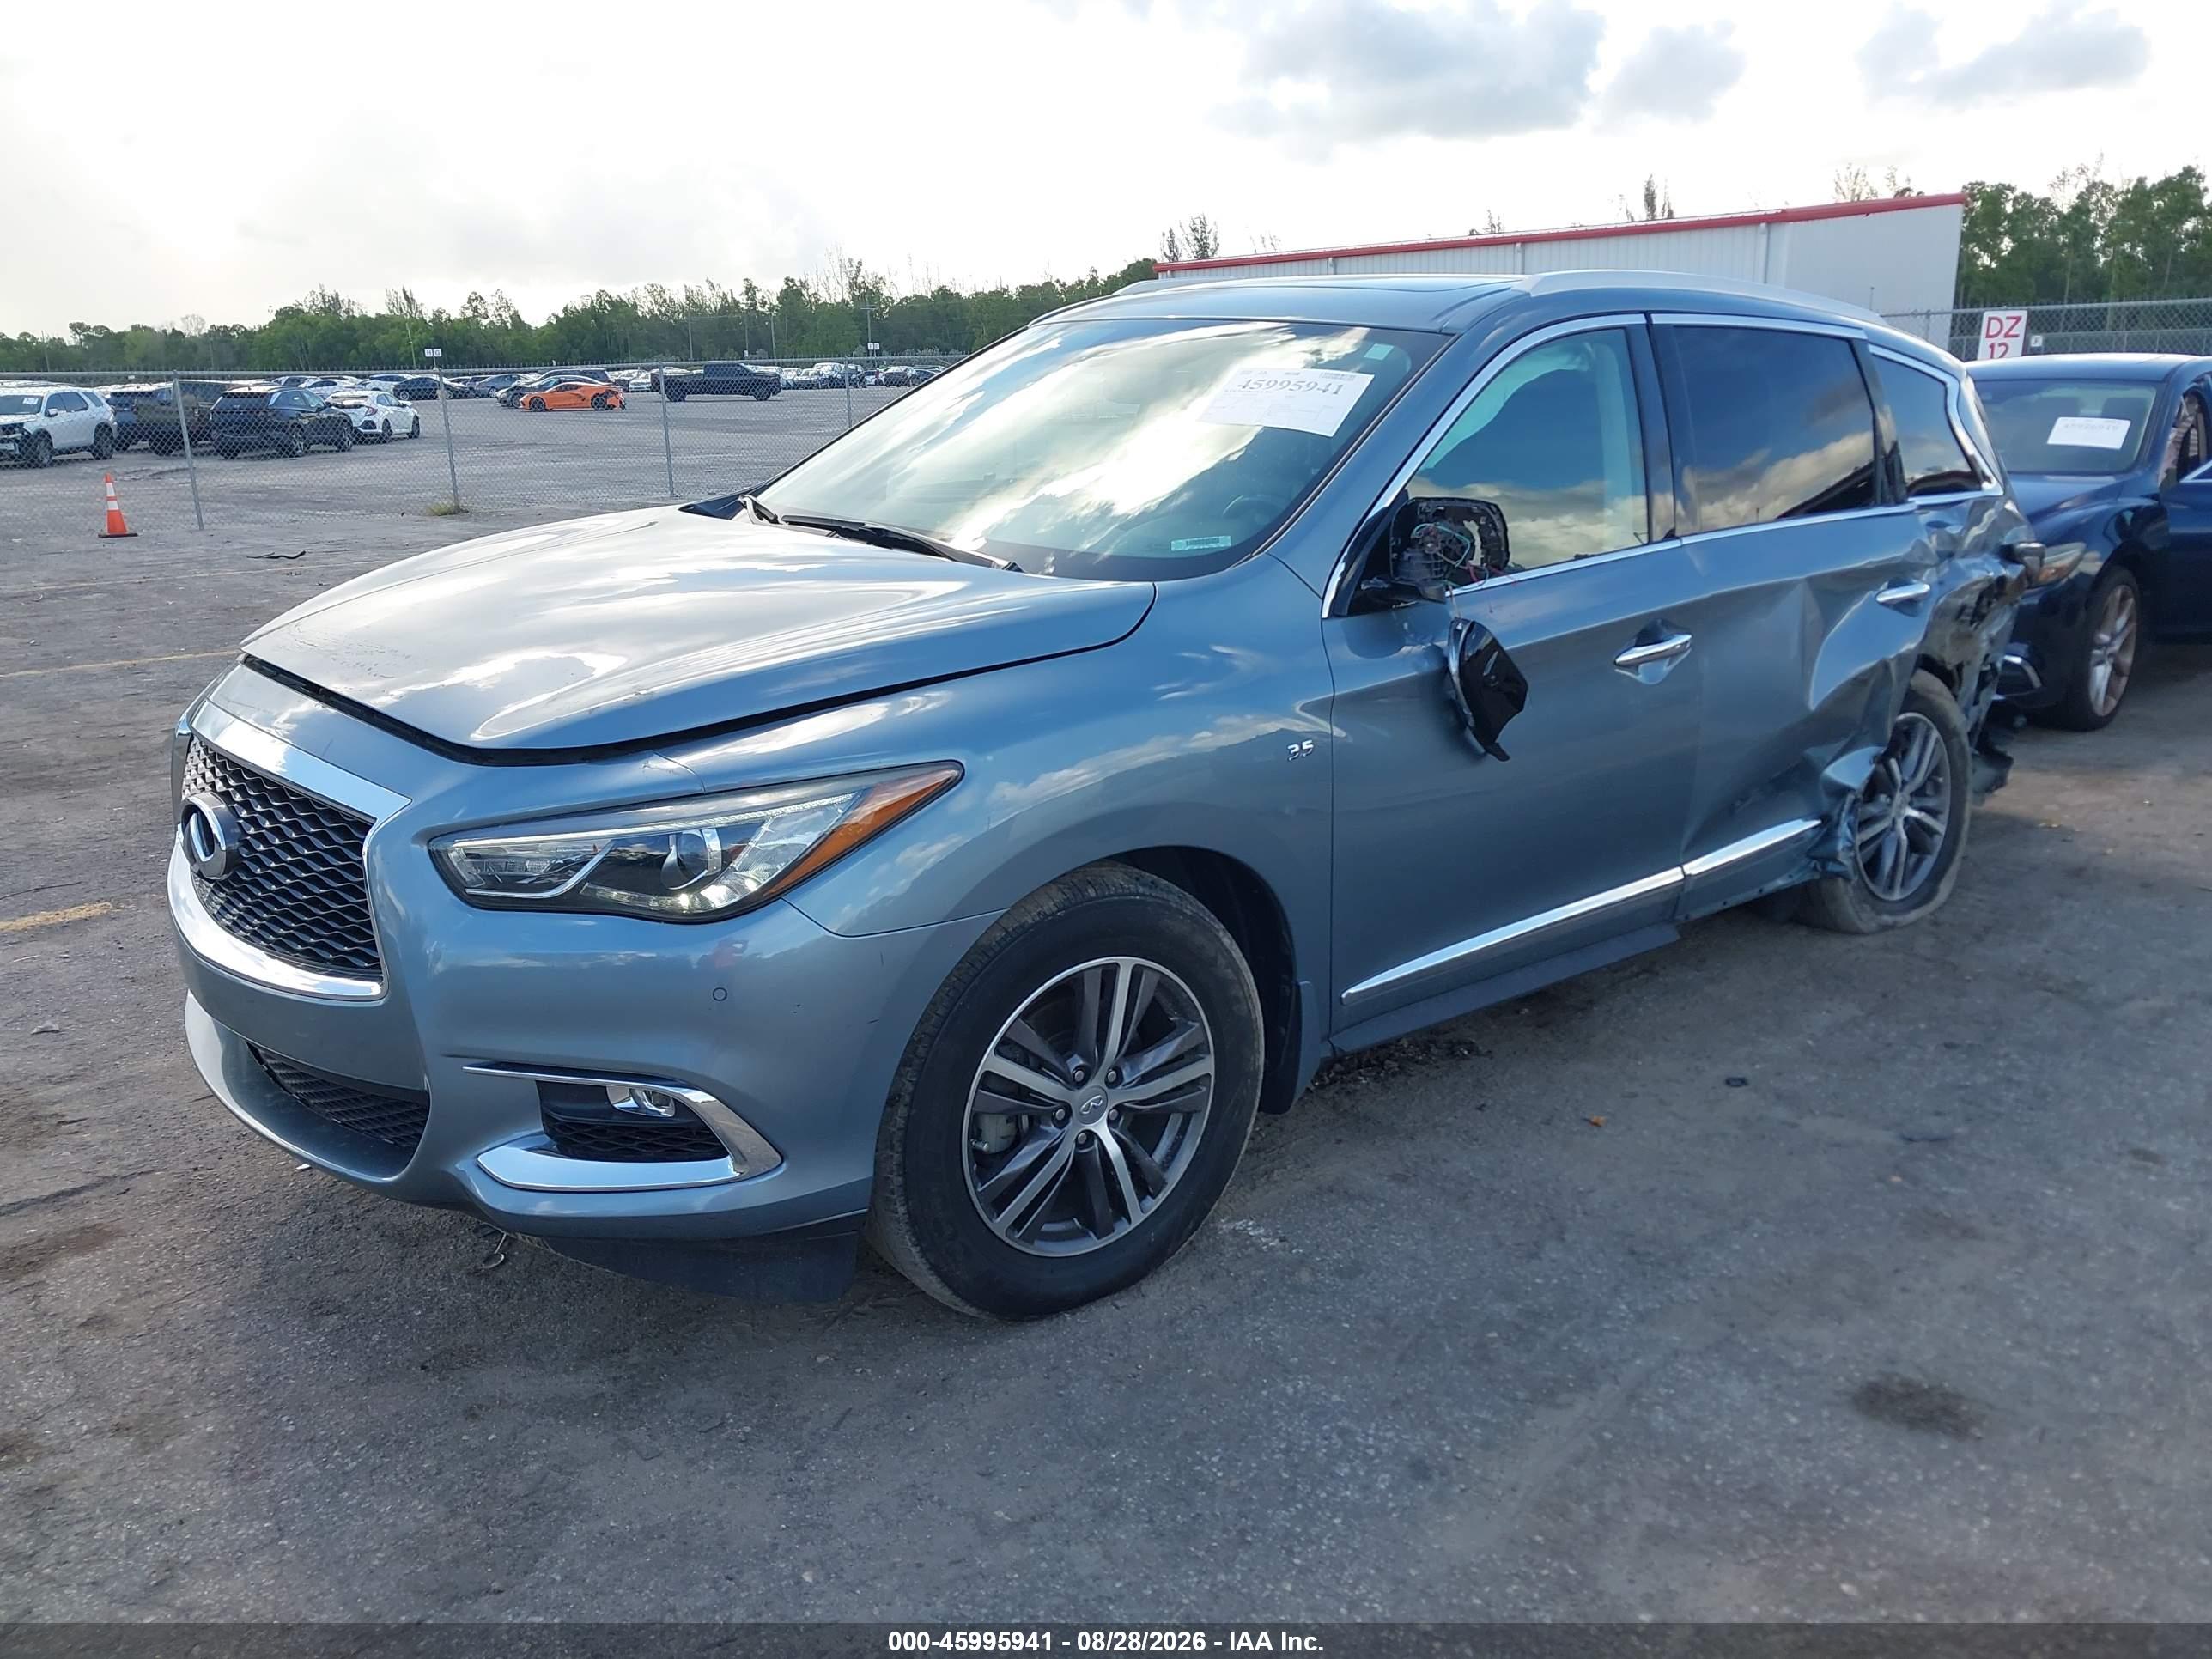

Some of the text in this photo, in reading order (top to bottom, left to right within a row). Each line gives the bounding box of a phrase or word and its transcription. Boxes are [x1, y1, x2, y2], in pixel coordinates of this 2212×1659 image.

[1985, 315, 2022, 338] DZ
[1988, 342, 2009, 359] 12
[1237, 379, 1344, 395] 45995941
